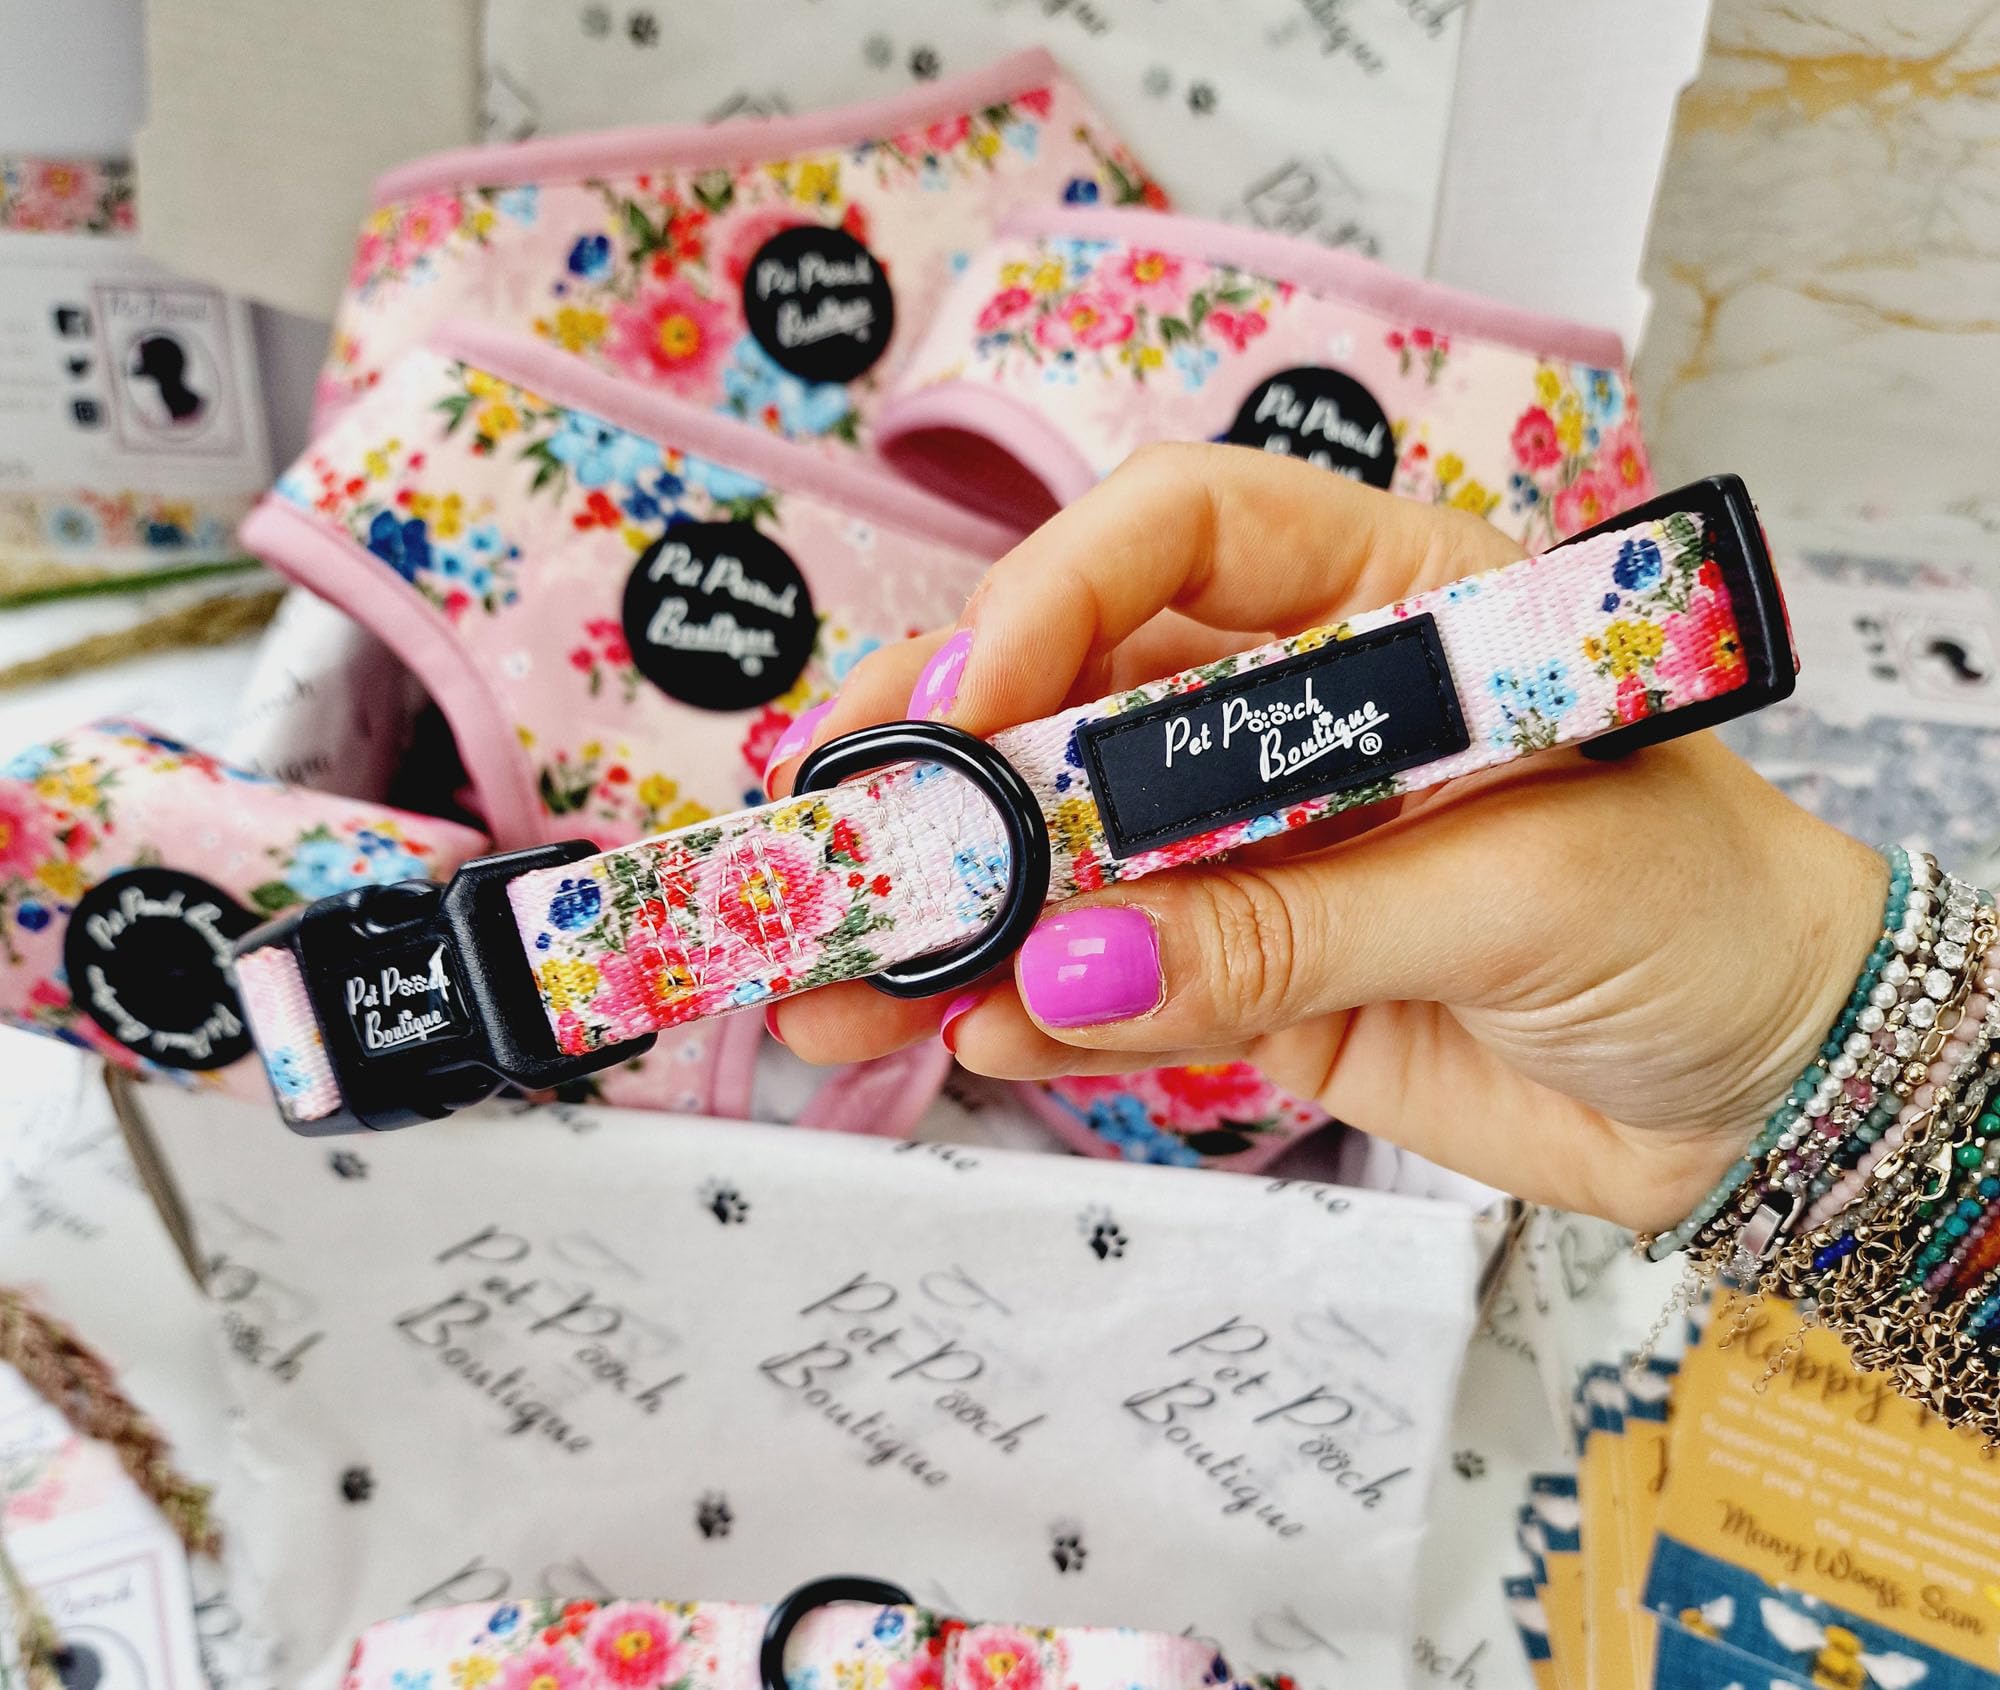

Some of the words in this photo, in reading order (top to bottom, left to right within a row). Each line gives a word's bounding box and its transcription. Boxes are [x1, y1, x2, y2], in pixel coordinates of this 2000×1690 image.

[1165, 716, 1212, 768] Pet
[1222, 677, 1323, 749] Pooch
[1259, 700, 1390, 783] Boutique
[345, 976, 380, 1015] Pet
[364, 1009, 450, 1050] Boutique
[434, 1224, 540, 1306] Pet
[394, 1290, 593, 1453] Boutique
[757, 1340, 948, 1486] Boutique
[799, 1272, 903, 1356] Pet
[888, 1339, 1047, 1455] Pooch
[1168, 1315, 1271, 1396] Pet
[1252, 1384, 1412, 1509] Pooch
[1121, 1378, 1305, 1537] Boutique
[1717, 1498, 1808, 1573] Many
[1918, 1583, 1986, 1636] Sam
